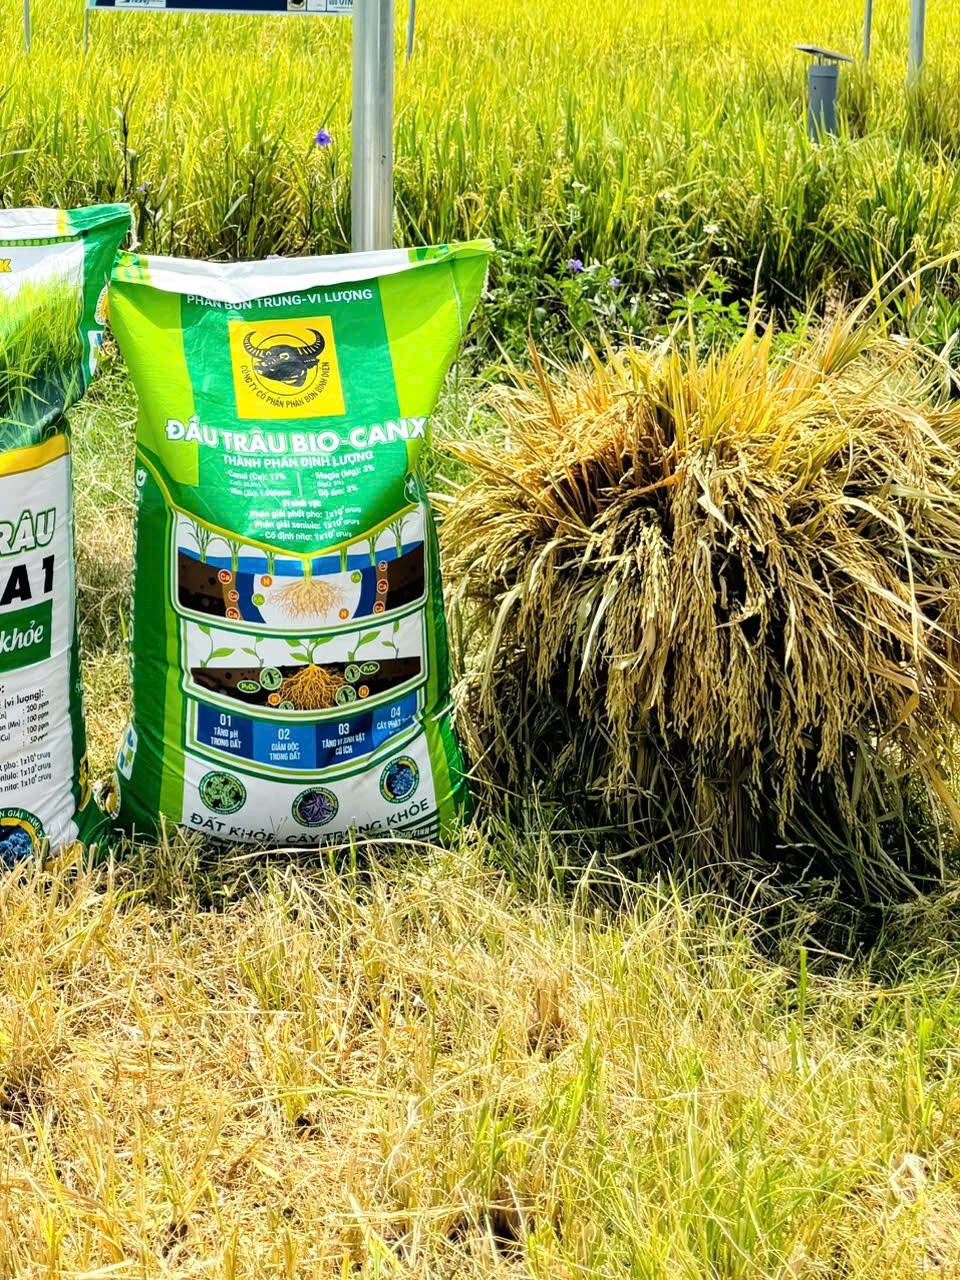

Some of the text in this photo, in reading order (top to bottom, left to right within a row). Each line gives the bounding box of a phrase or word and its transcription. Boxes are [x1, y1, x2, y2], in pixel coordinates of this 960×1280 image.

[257, 289, 373, 309] TRUNG-VI LƯỢNG
[165, 415, 428, 454] ĐẦU TRÂU BIO-CANX
[42, 554, 55, 594] 1
[220, 714, 232, 726] 01
[391, 706, 401, 718] 04
[278, 728, 290, 740] 02
[338, 723, 350, 735] 03
[386, 797, 430, 824] KHỎE
[190, 810, 226, 833] ĐẤT
